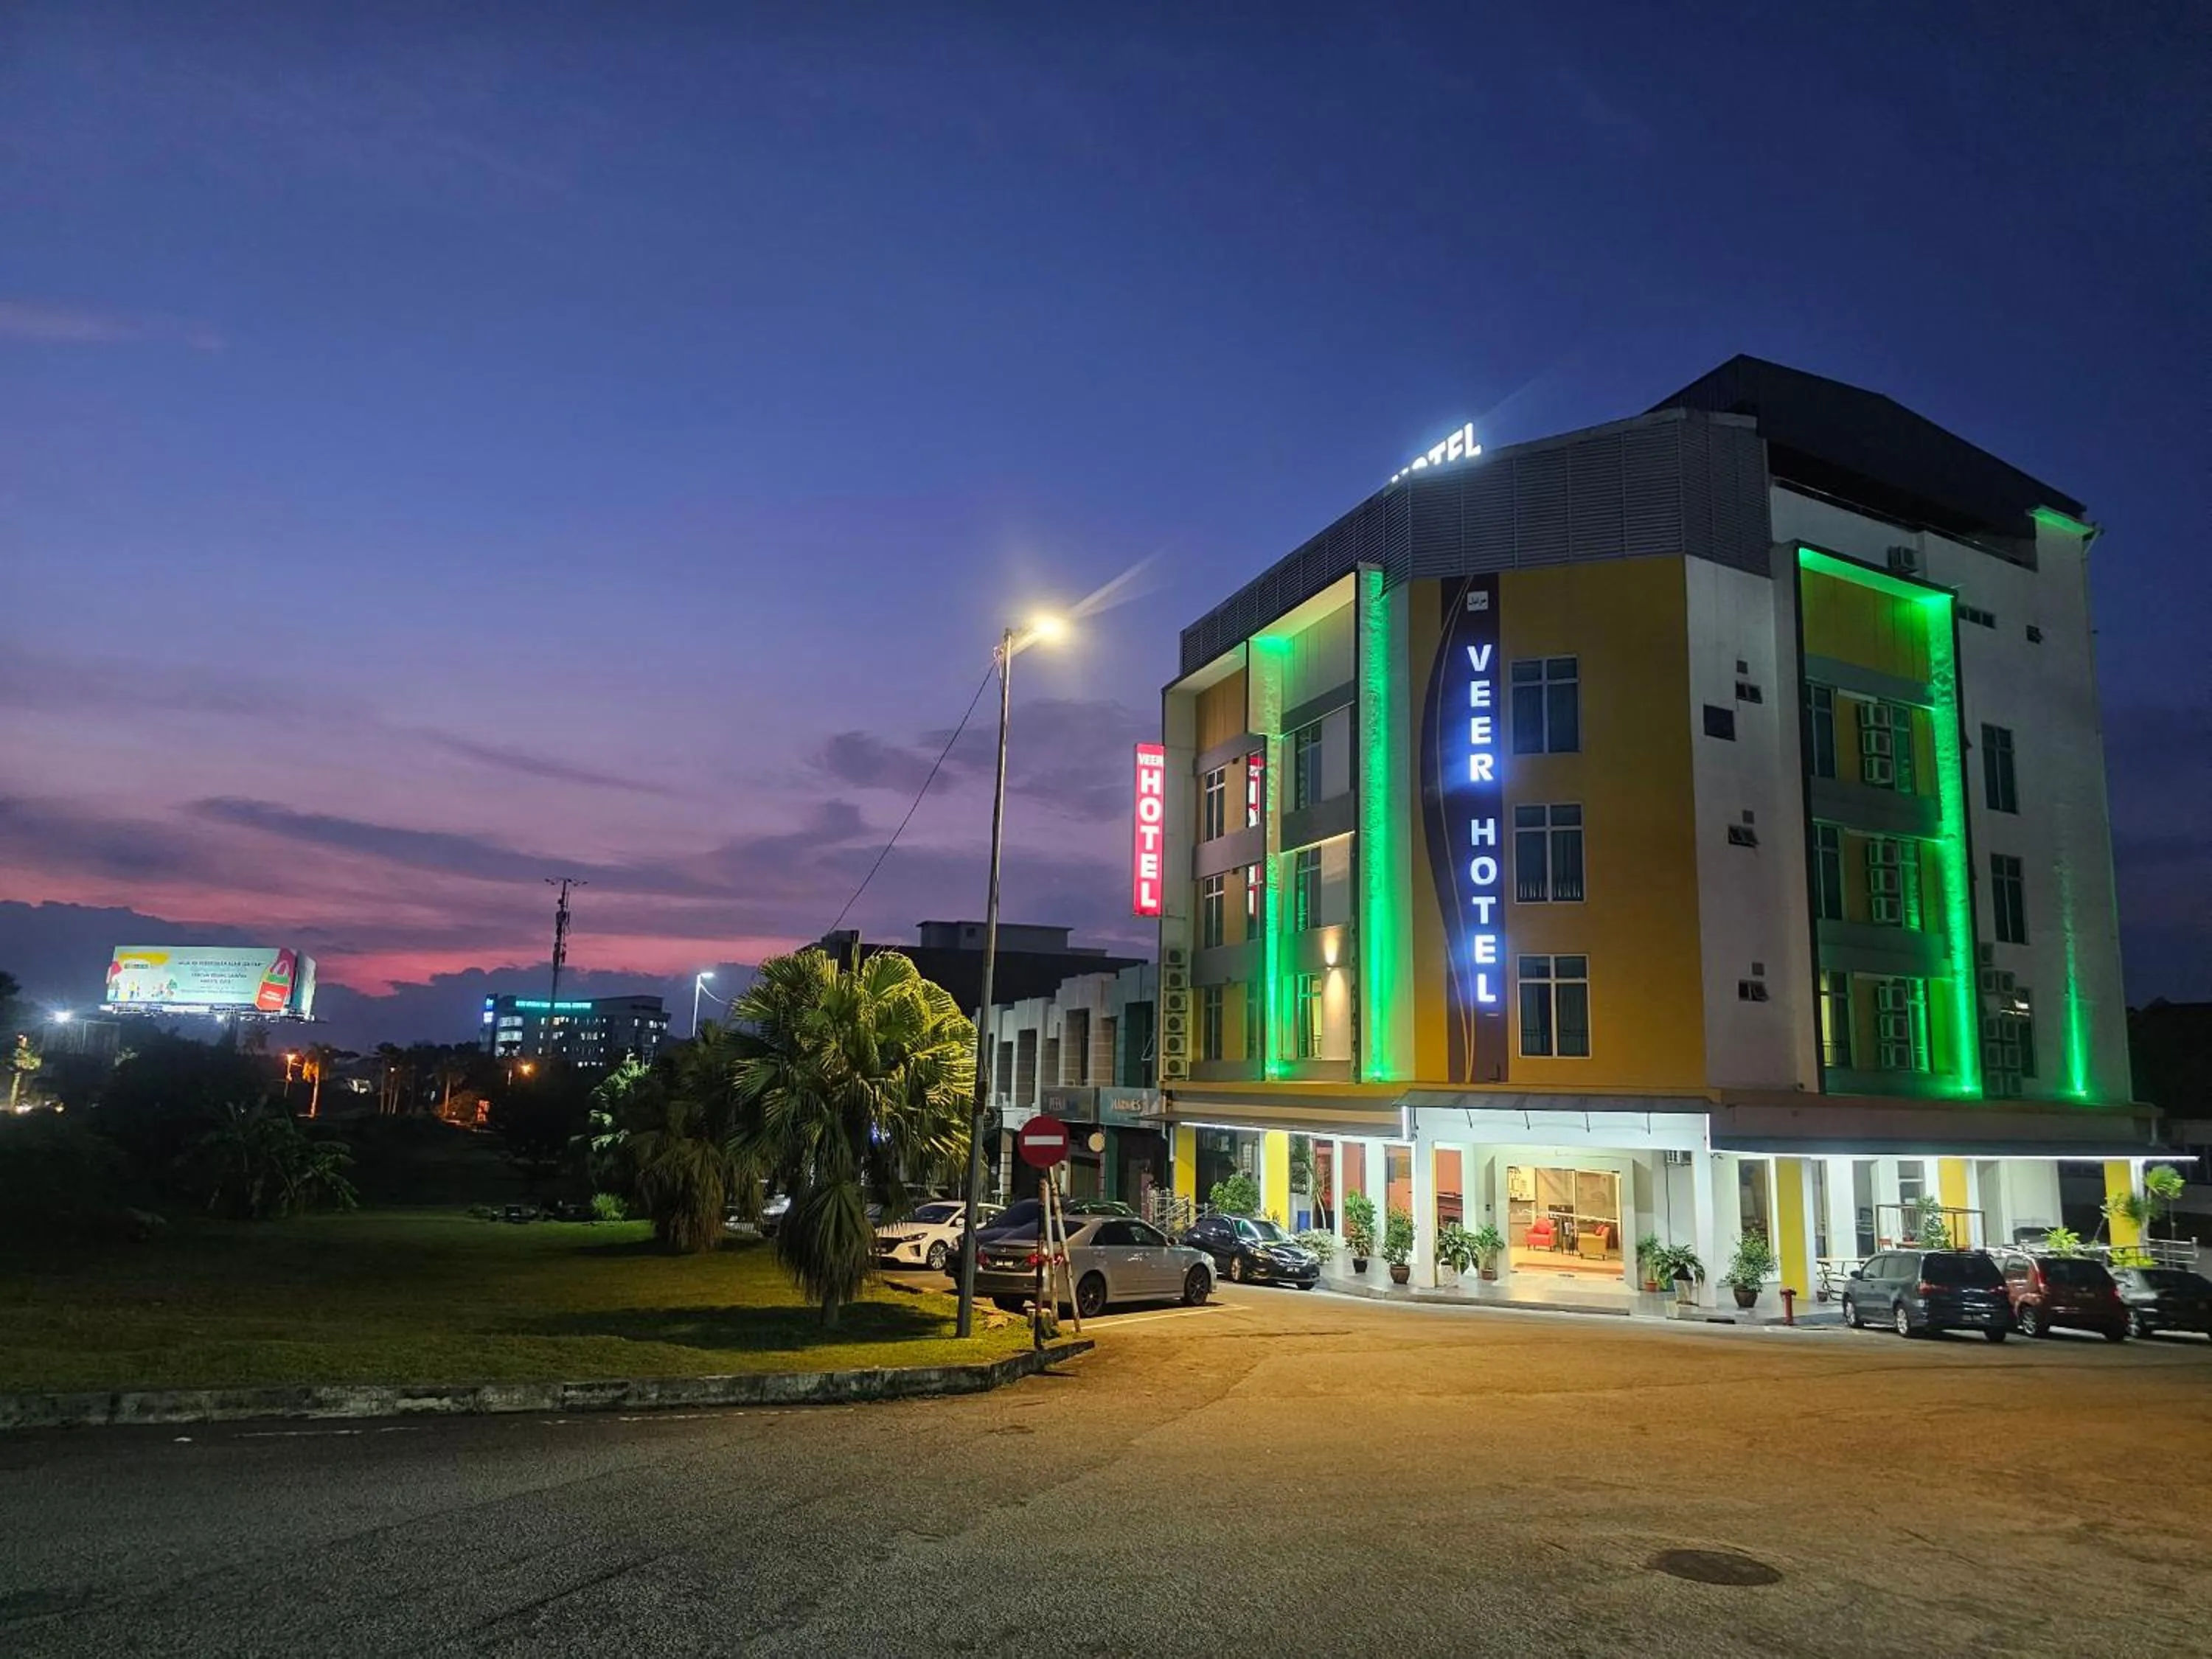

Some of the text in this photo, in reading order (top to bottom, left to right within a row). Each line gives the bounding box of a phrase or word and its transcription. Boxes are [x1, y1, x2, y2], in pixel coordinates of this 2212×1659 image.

[1391, 422, 1481, 484] OTEL
[1139, 769, 1161, 908] HOTEL
[1467, 644, 1498, 1003] VEER HOTEL
